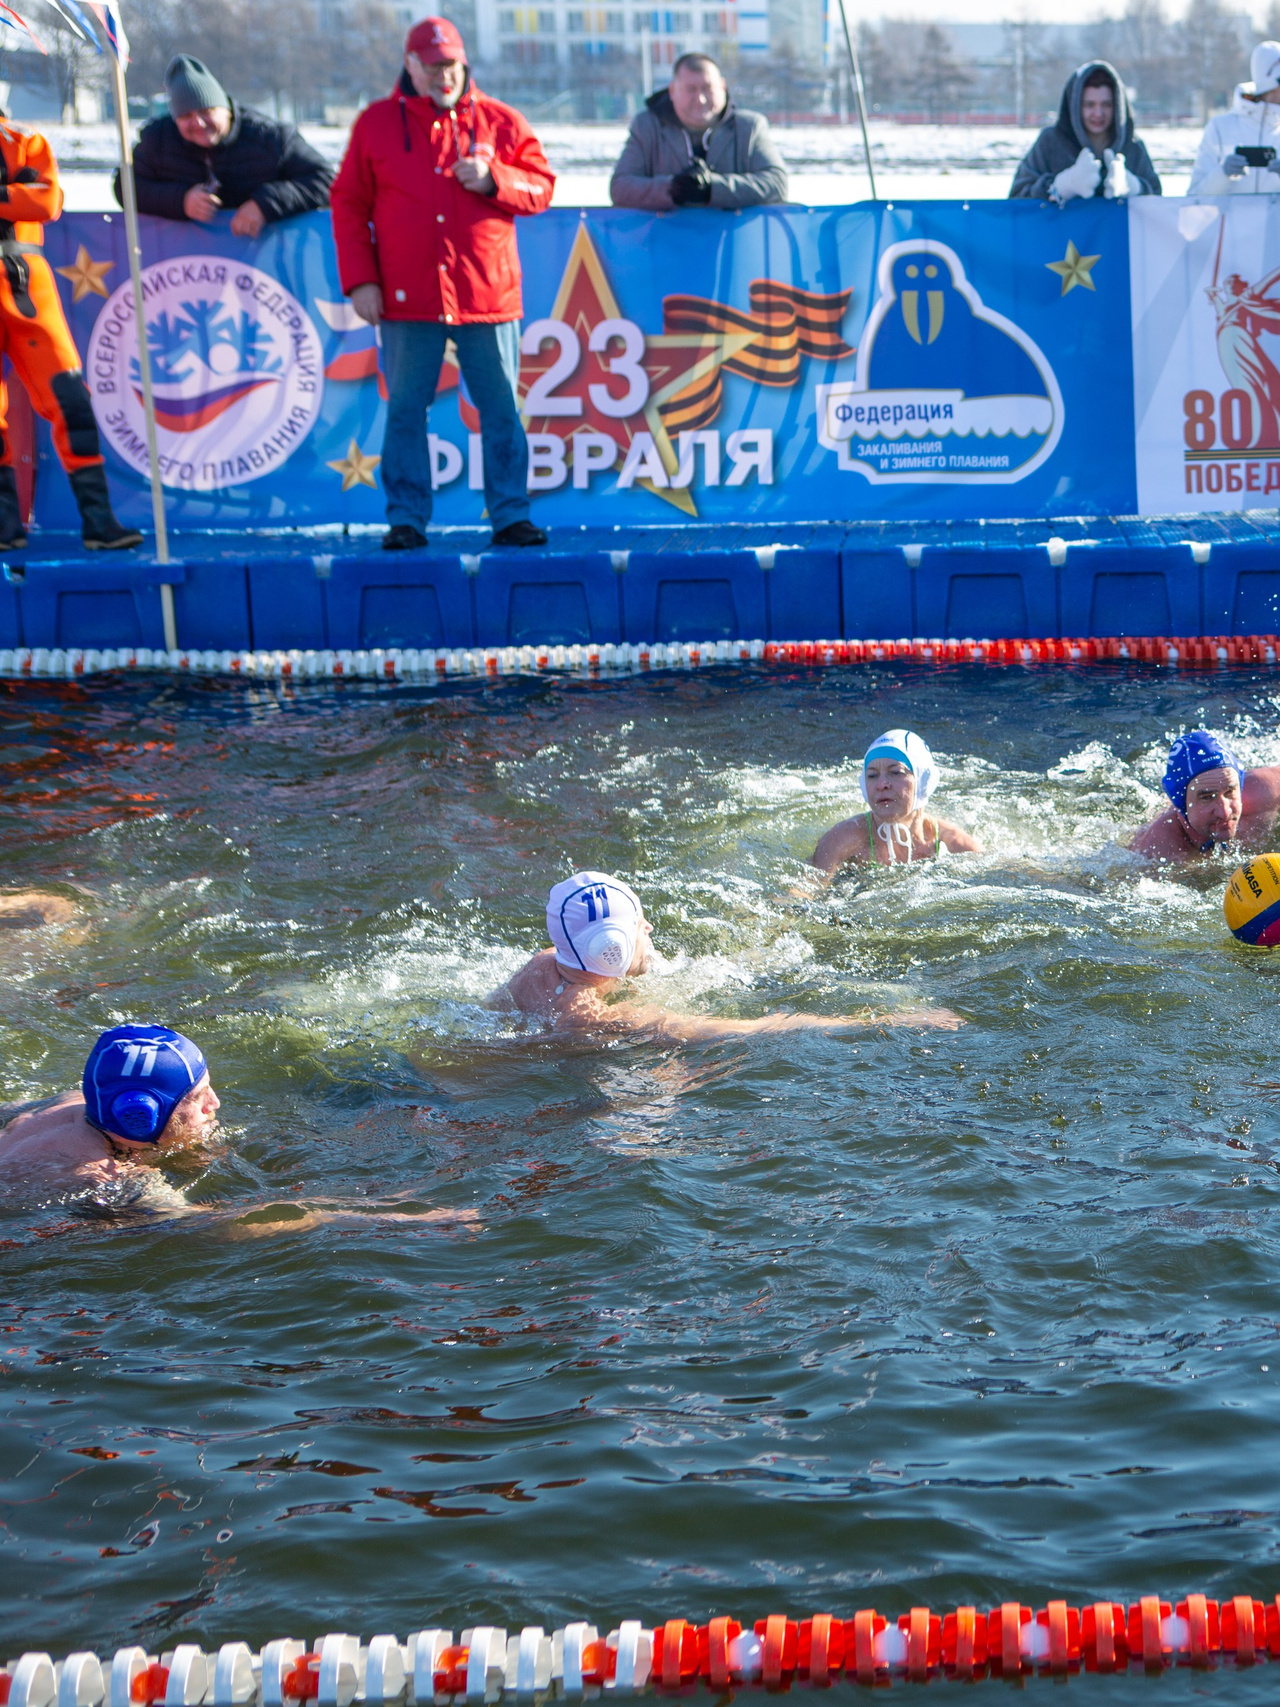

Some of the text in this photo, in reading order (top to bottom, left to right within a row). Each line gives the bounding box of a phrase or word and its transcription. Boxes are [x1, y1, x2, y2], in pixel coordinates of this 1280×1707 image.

[235, 273, 316, 393] ФЕДЕРАЦИЯ
[521, 318, 650, 418] 23
[834, 402, 954, 426] Федерация
[1183, 388, 1253, 451] 80
[202, 406, 311, 482] ПЛАВАНИЯ
[857, 440, 943, 457] ЗАКАЛИВАНИЯ
[880, 454, 1009, 470] И ЗИМНЕГО ПЛАВАНИЯ
[581, 887, 611, 923] 11
[120, 1045, 158, 1077] 11
